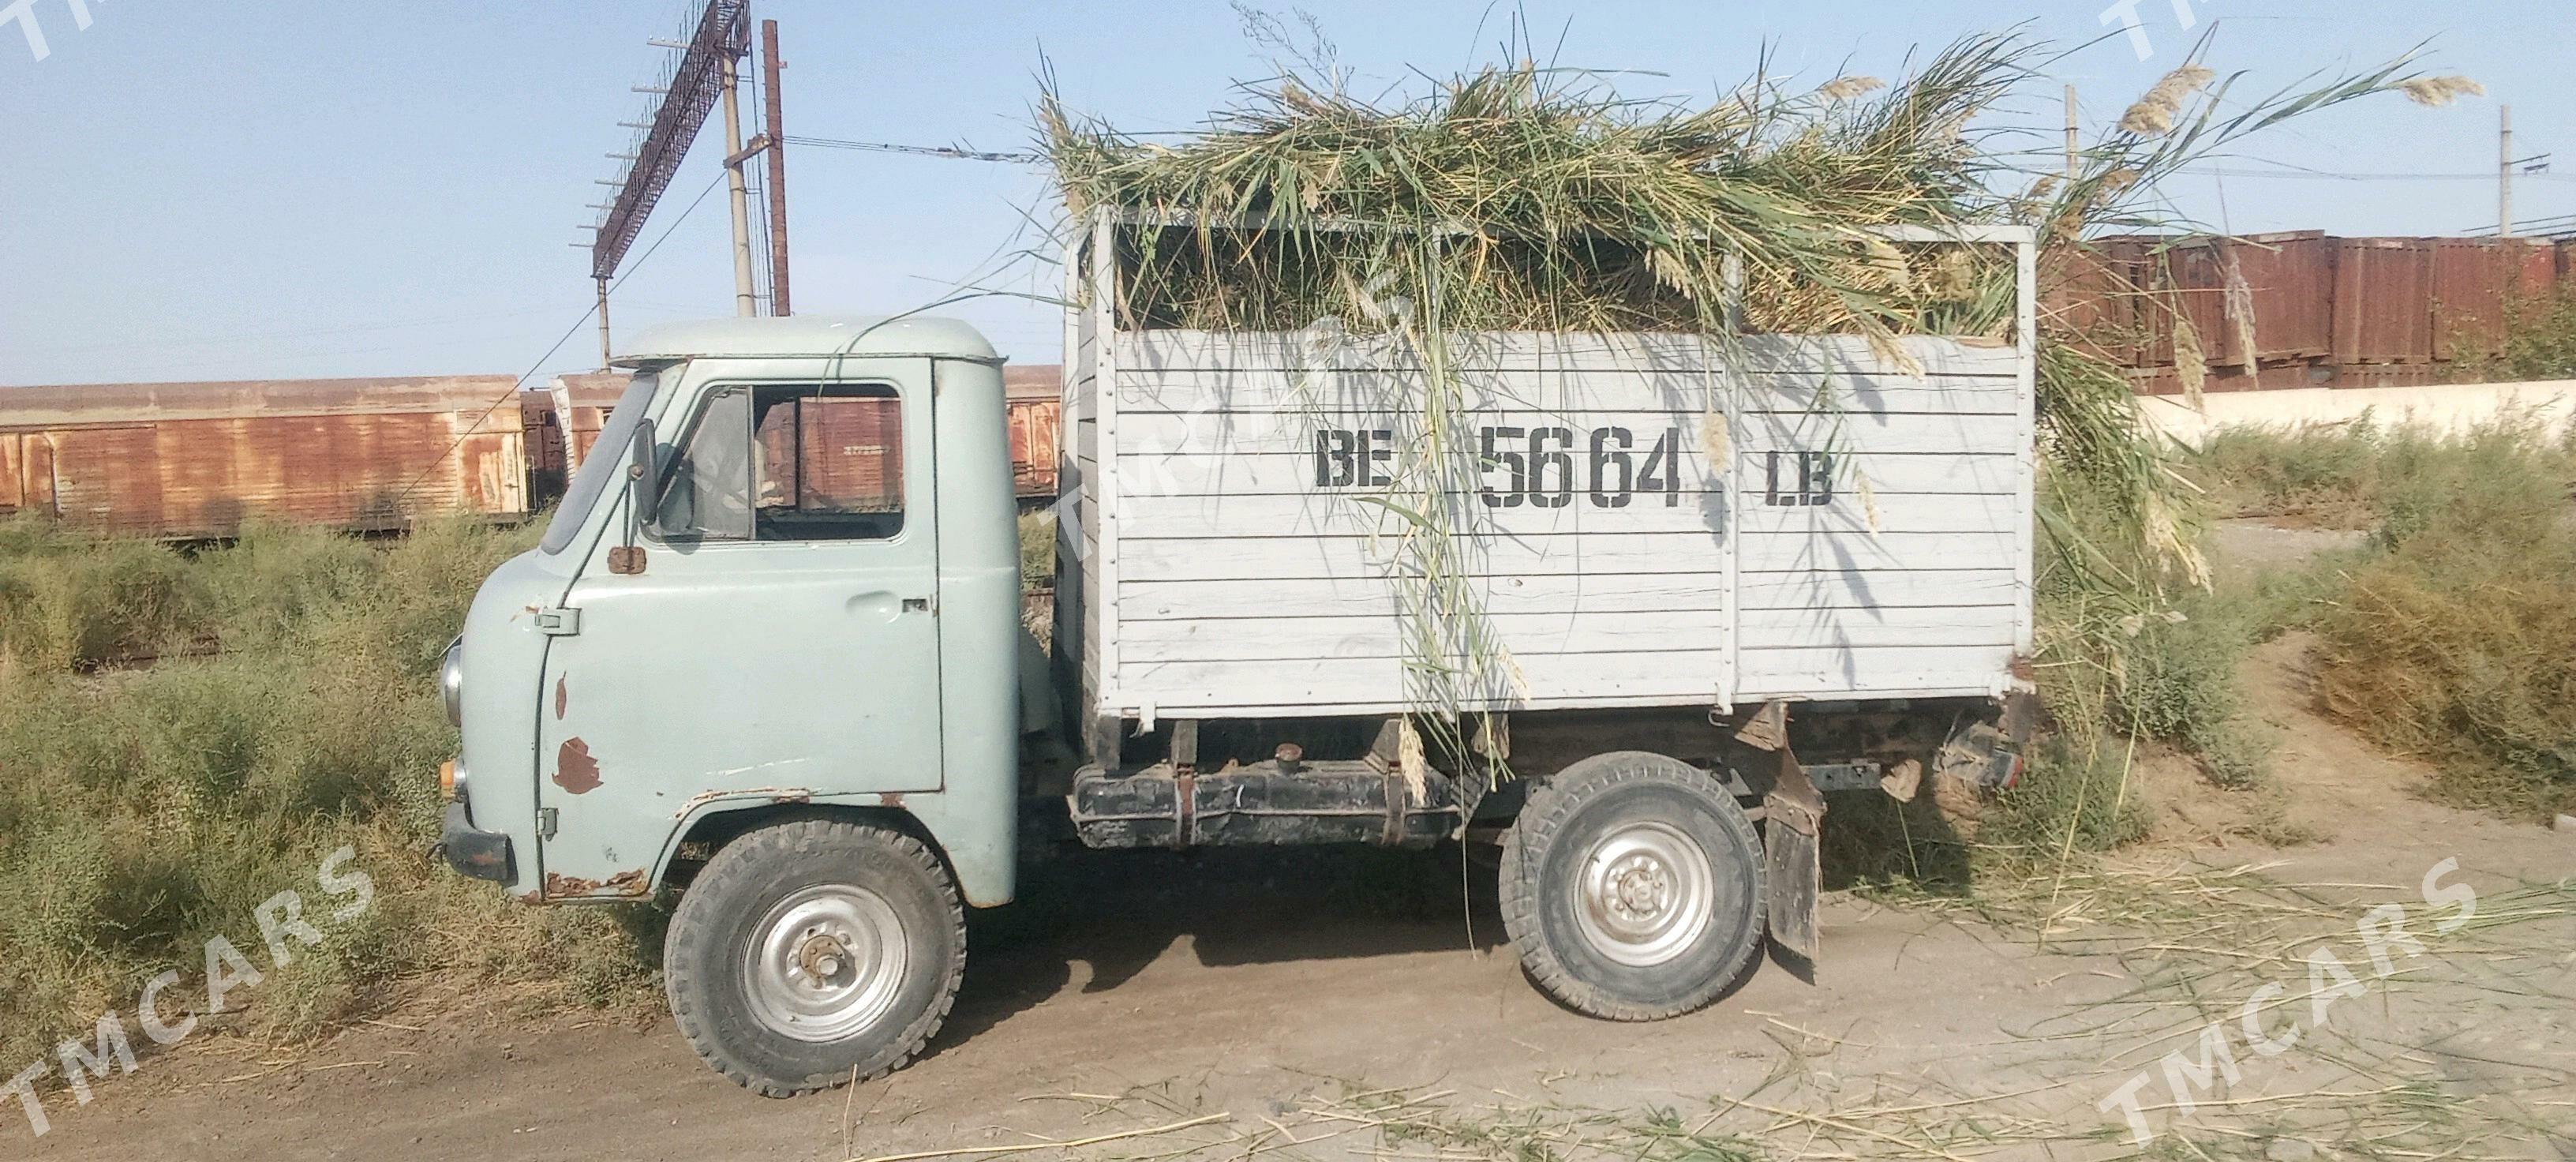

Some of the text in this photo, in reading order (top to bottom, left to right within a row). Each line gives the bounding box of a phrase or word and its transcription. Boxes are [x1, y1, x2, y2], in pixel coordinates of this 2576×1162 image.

[1316, 426, 1833, 508] BE 5664 LB
